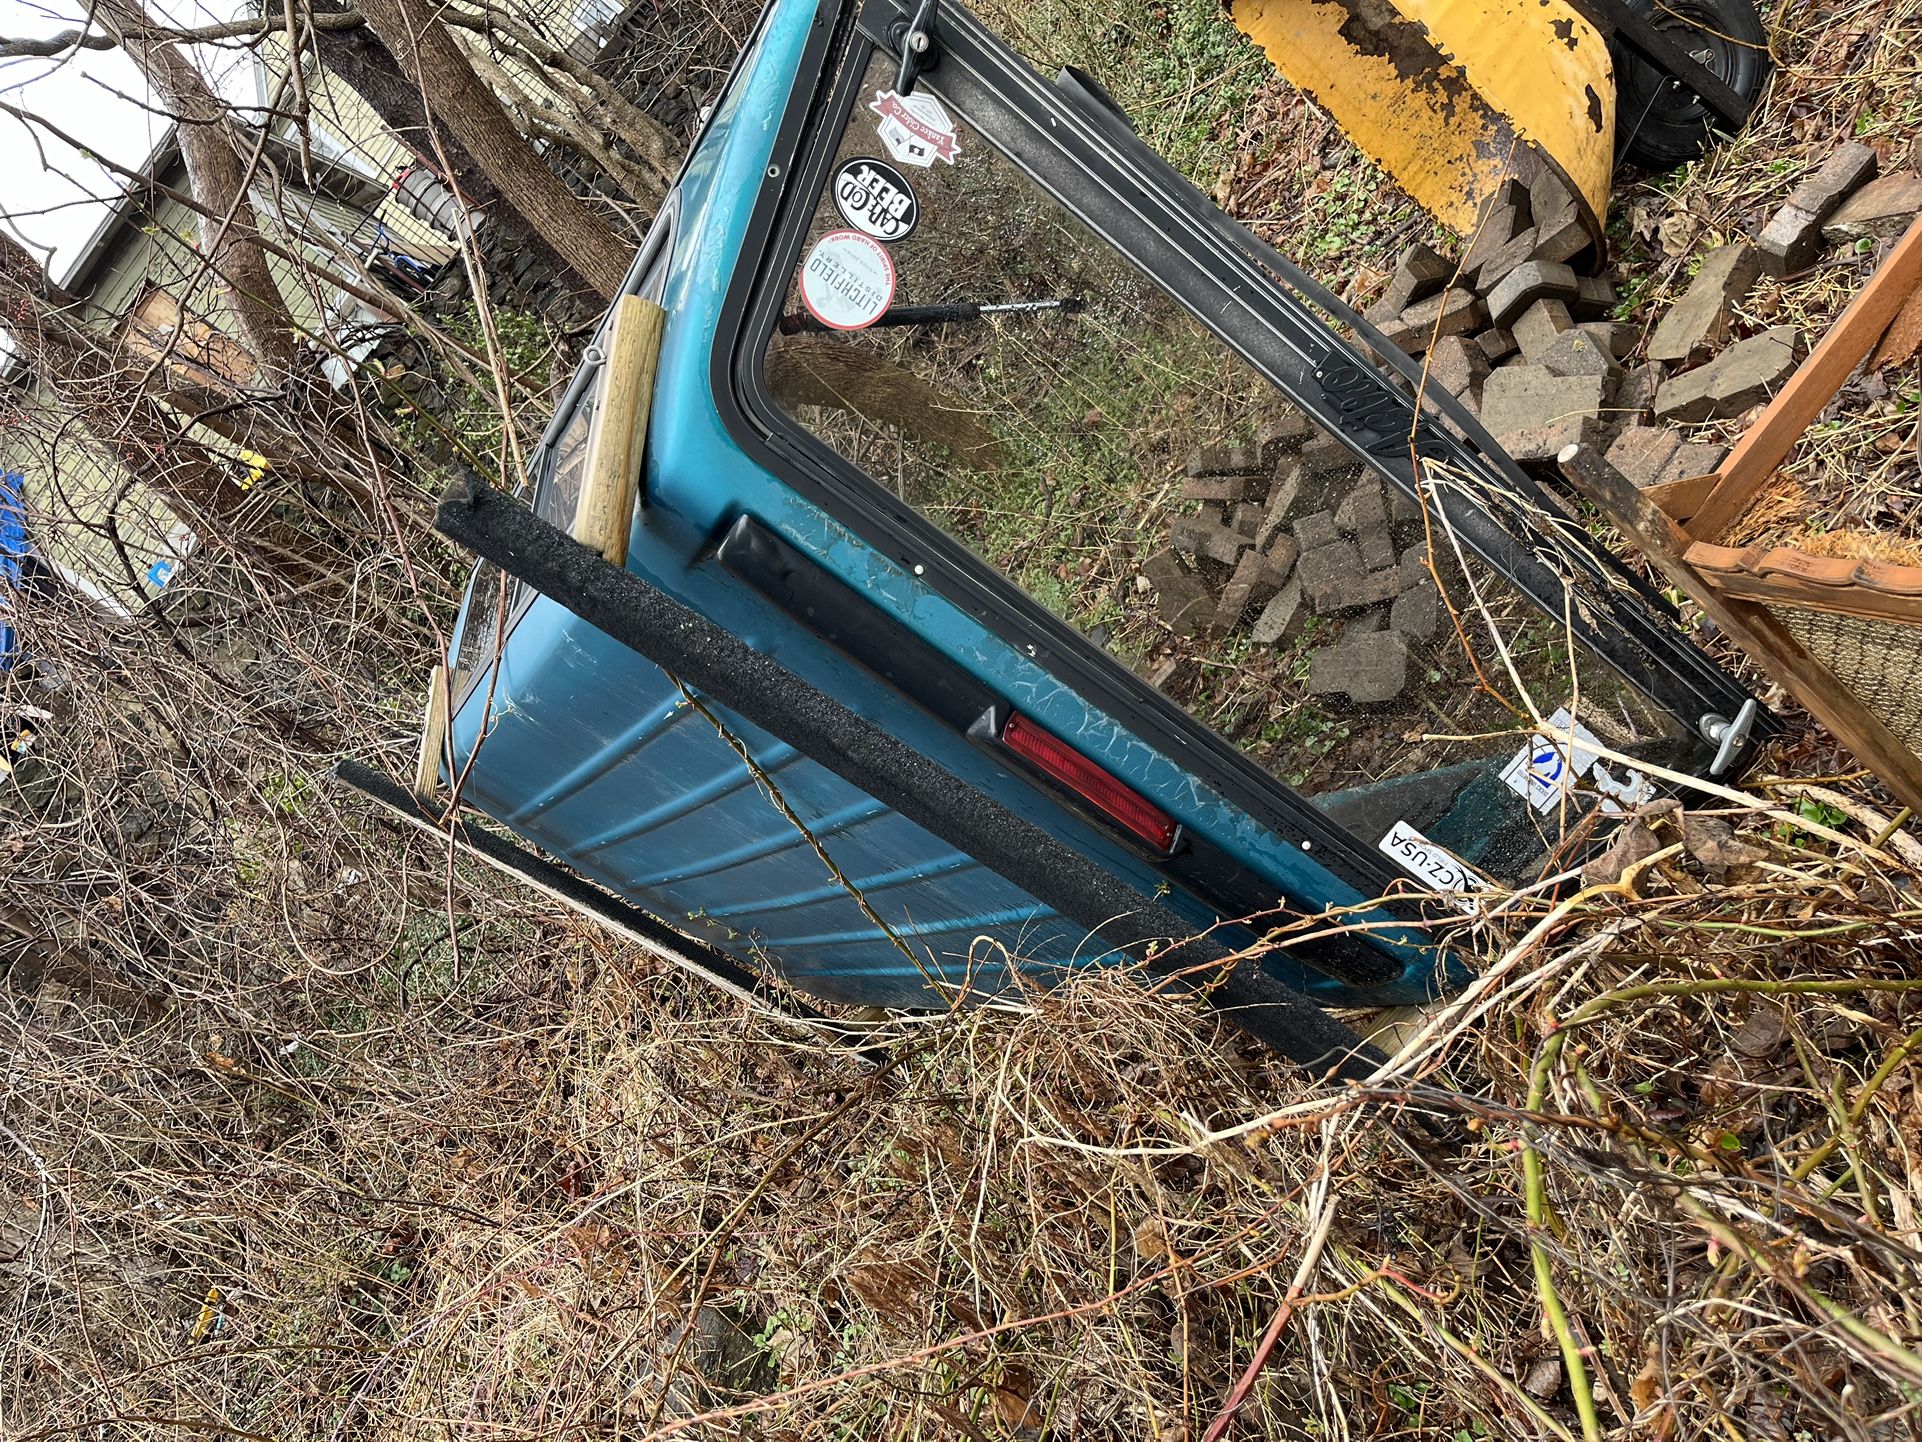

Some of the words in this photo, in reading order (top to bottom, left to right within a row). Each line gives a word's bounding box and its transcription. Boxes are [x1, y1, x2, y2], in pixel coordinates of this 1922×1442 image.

[901, 112, 920, 131] Cider
[919, 123, 945, 146] Yankee
[856, 164, 912, 220] BEER
[852, 234, 870, 246] HARD
[869, 244, 878, 252] OF
[877, 251, 890, 272] SPIRIT
[810, 258, 878, 316] LITCHFIELD
